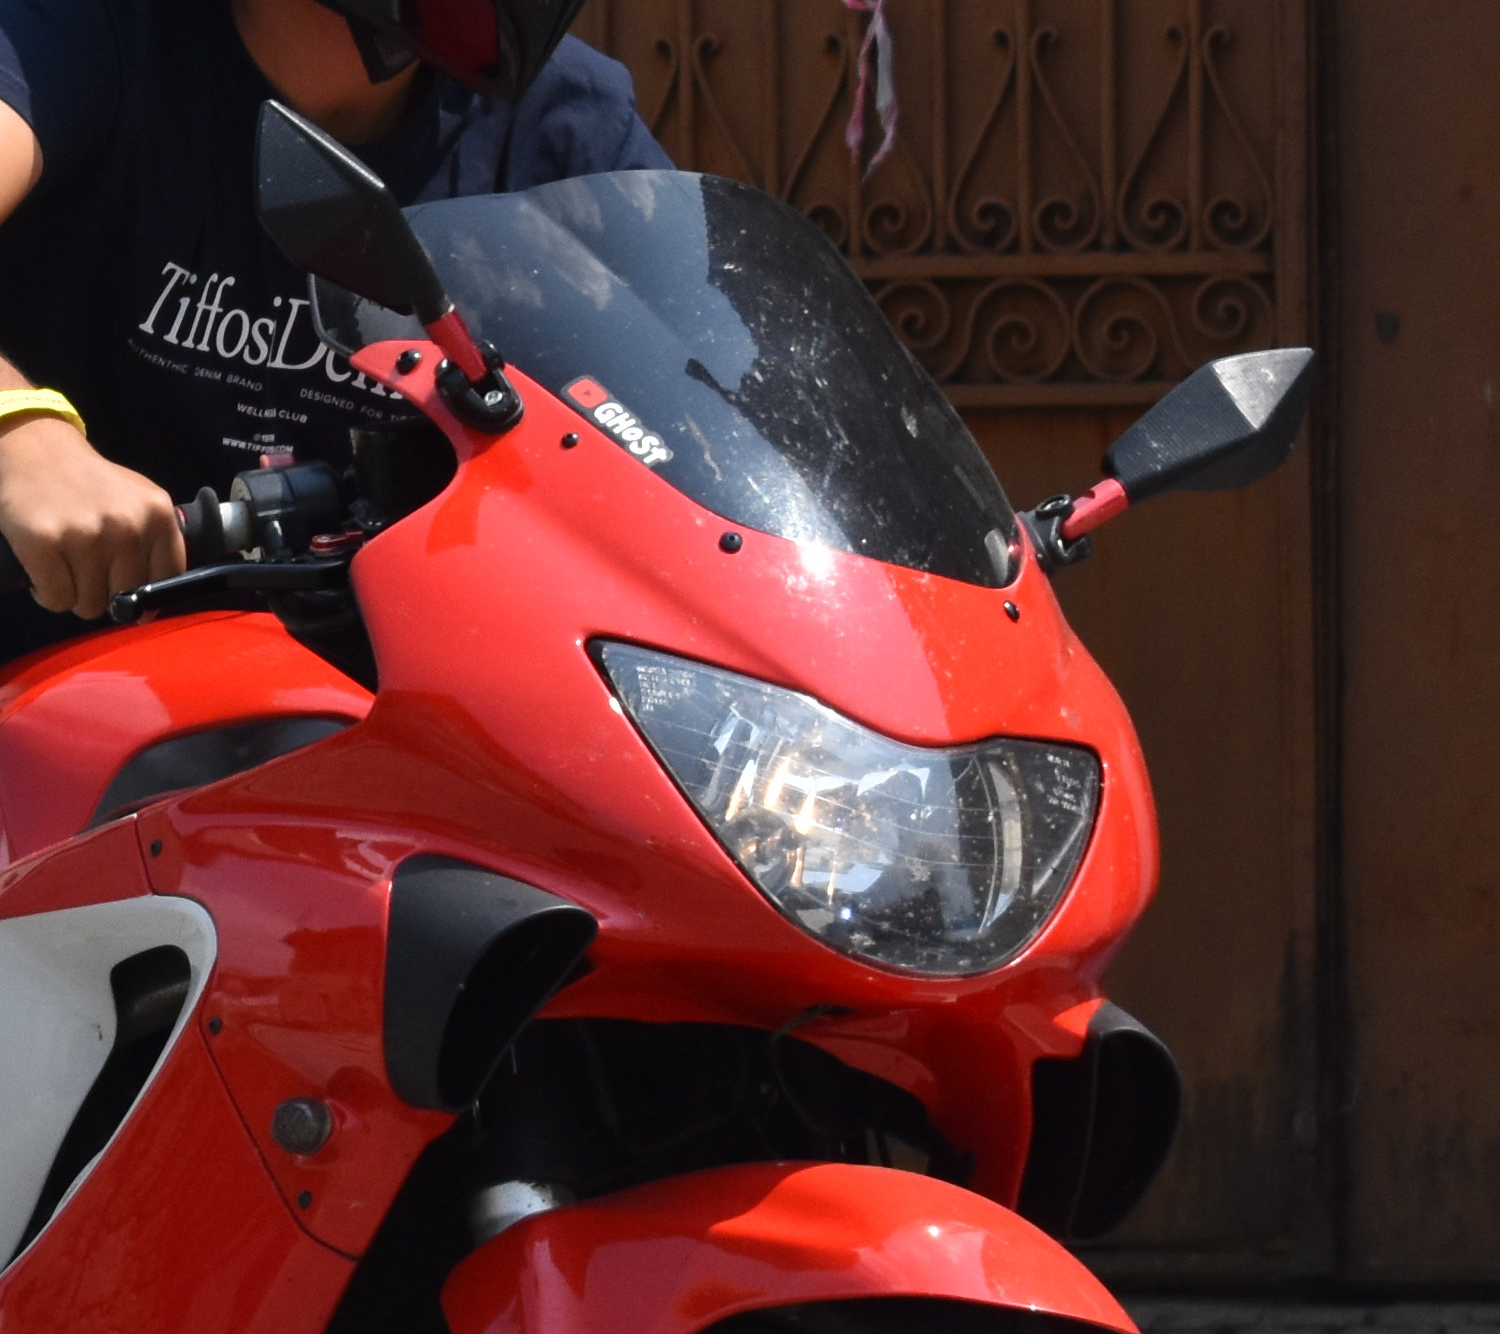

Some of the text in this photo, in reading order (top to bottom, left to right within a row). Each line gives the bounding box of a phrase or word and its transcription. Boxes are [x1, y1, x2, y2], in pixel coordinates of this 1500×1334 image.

[226, 374, 263, 392] BRAND
[300, 388, 354, 411] DESIGNED
[278, 409, 308, 424] CLUB
